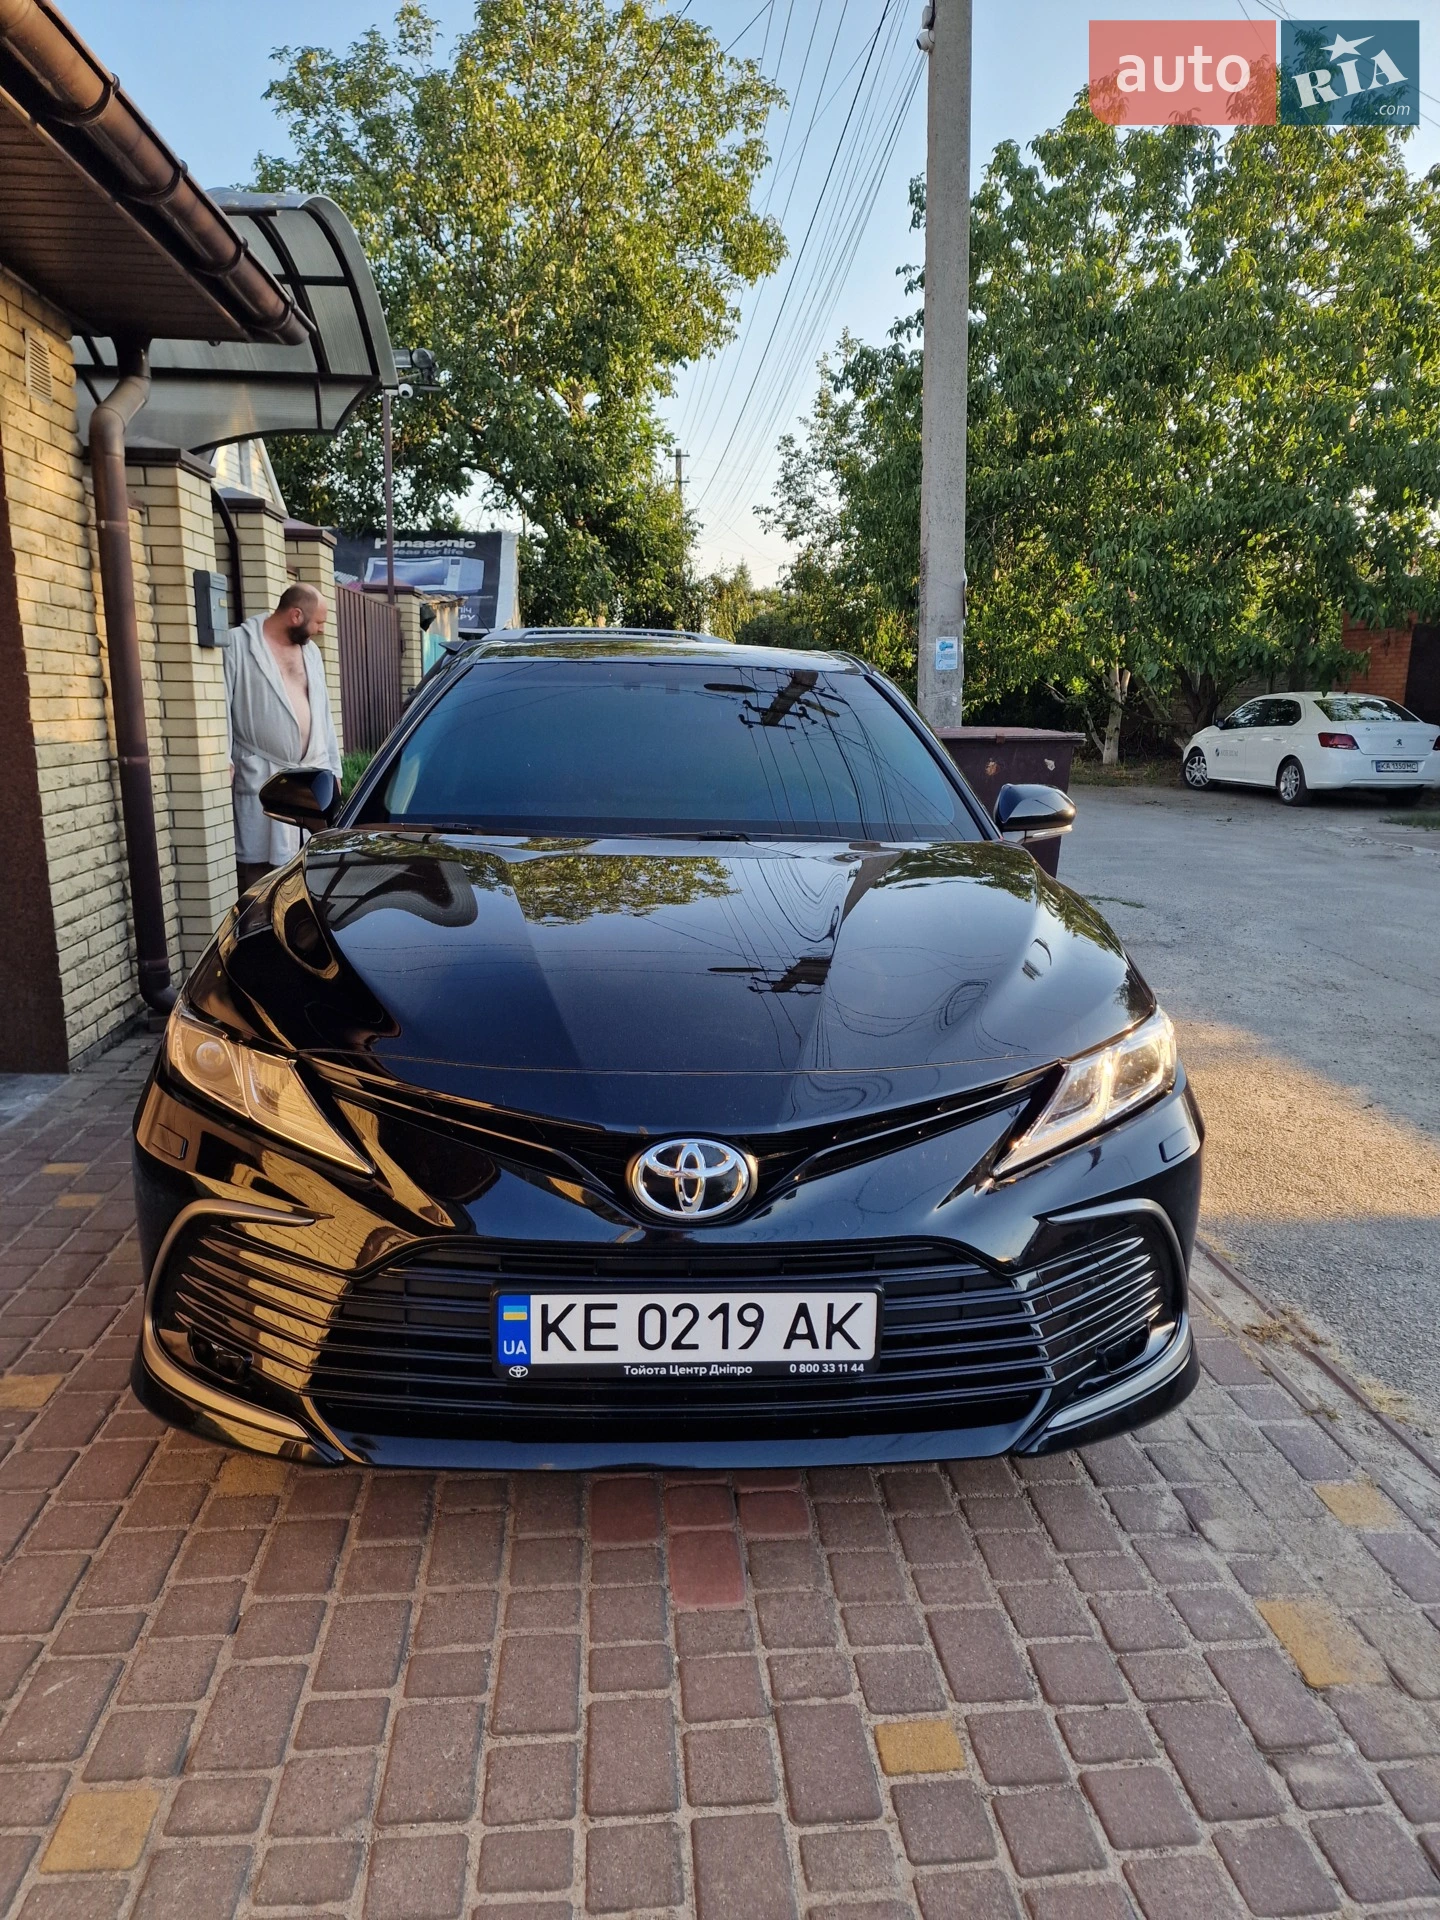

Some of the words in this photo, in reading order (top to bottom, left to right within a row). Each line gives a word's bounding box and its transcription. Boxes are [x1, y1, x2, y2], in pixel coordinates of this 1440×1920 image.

[443, 547, 464, 555] life
[540, 1303, 619, 1352] KE
[637, 1301, 765, 1351] 0219
[782, 1302, 864, 1351] AK
[503, 1340, 528, 1356] UA
[624, 1365, 667, 1375] Тойота
[669, 1364, 708, 1377] Центр
[709, 1364, 753, 1376] Дніпро
[789, 1363, 797, 1373] 0
[799, 1363, 820, 1373] 800
[822, 1363, 836, 1373] 33
[838, 1363, 848, 1373] 11
[850, 1363, 865, 1373] 44
